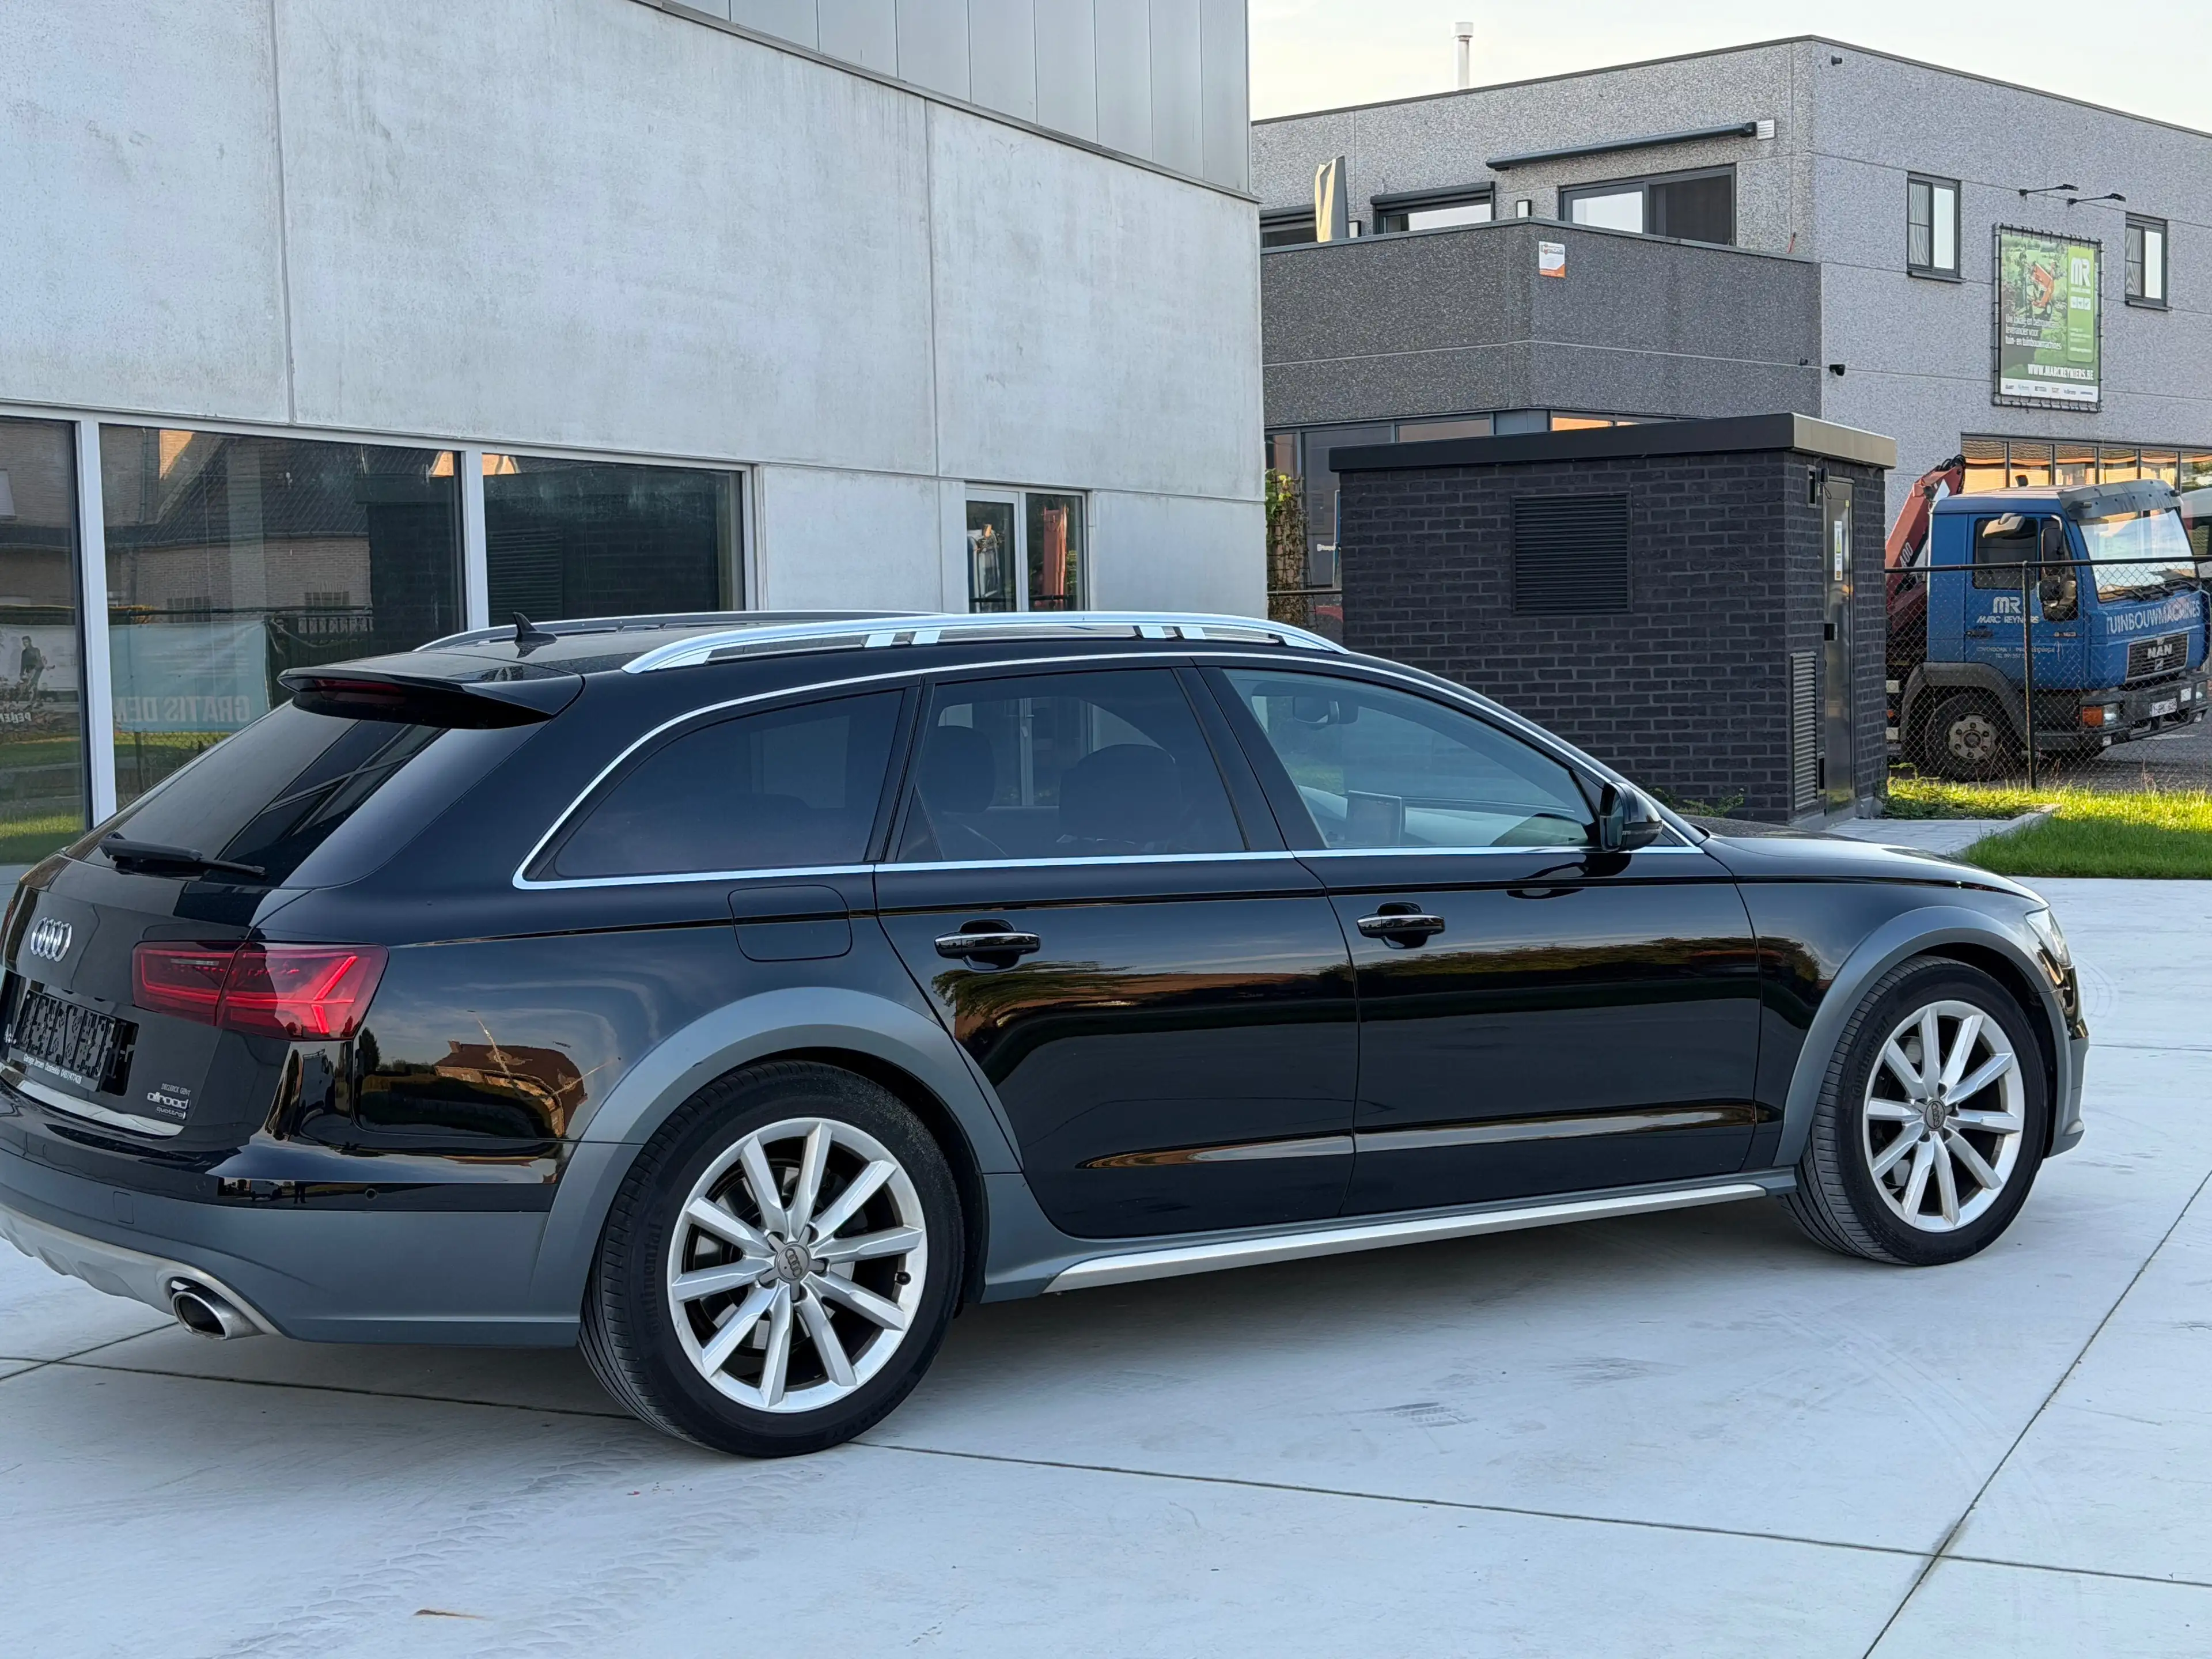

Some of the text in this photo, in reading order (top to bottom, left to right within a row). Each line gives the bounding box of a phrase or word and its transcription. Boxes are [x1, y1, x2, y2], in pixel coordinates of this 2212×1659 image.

[2070, 257, 2091, 287] MR
[1993, 596, 2021, 613] MR
[2004, 615, 2039, 623] REYNRS
[2147, 644, 2172, 659] MAN
[147, 1092, 189, 1109] allroad
[156, 1106, 184, 1118] quattro
